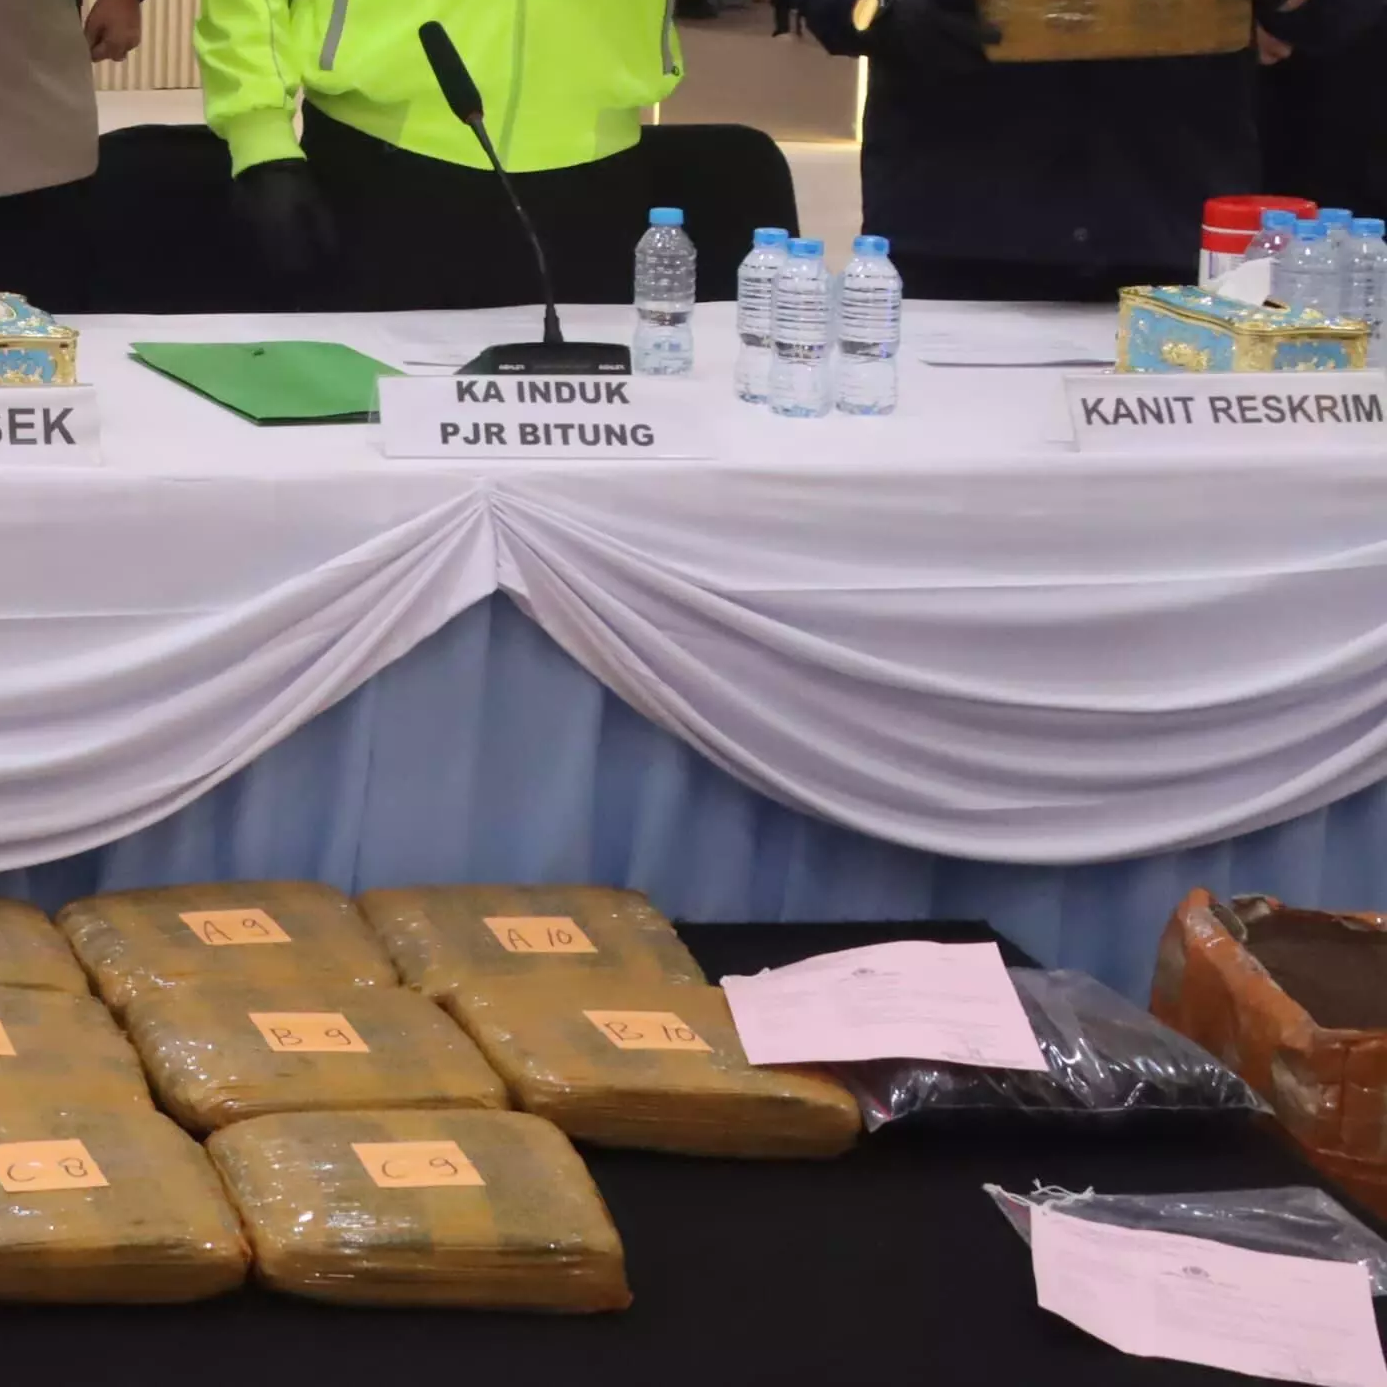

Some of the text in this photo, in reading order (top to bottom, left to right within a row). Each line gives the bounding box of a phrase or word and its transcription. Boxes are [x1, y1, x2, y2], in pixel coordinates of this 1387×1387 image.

[456, 380, 630, 404] KA INDUK
[1081, 393, 1384, 426] KANIT RESKRIM
[440, 422, 654, 447] PJR BITUNG
